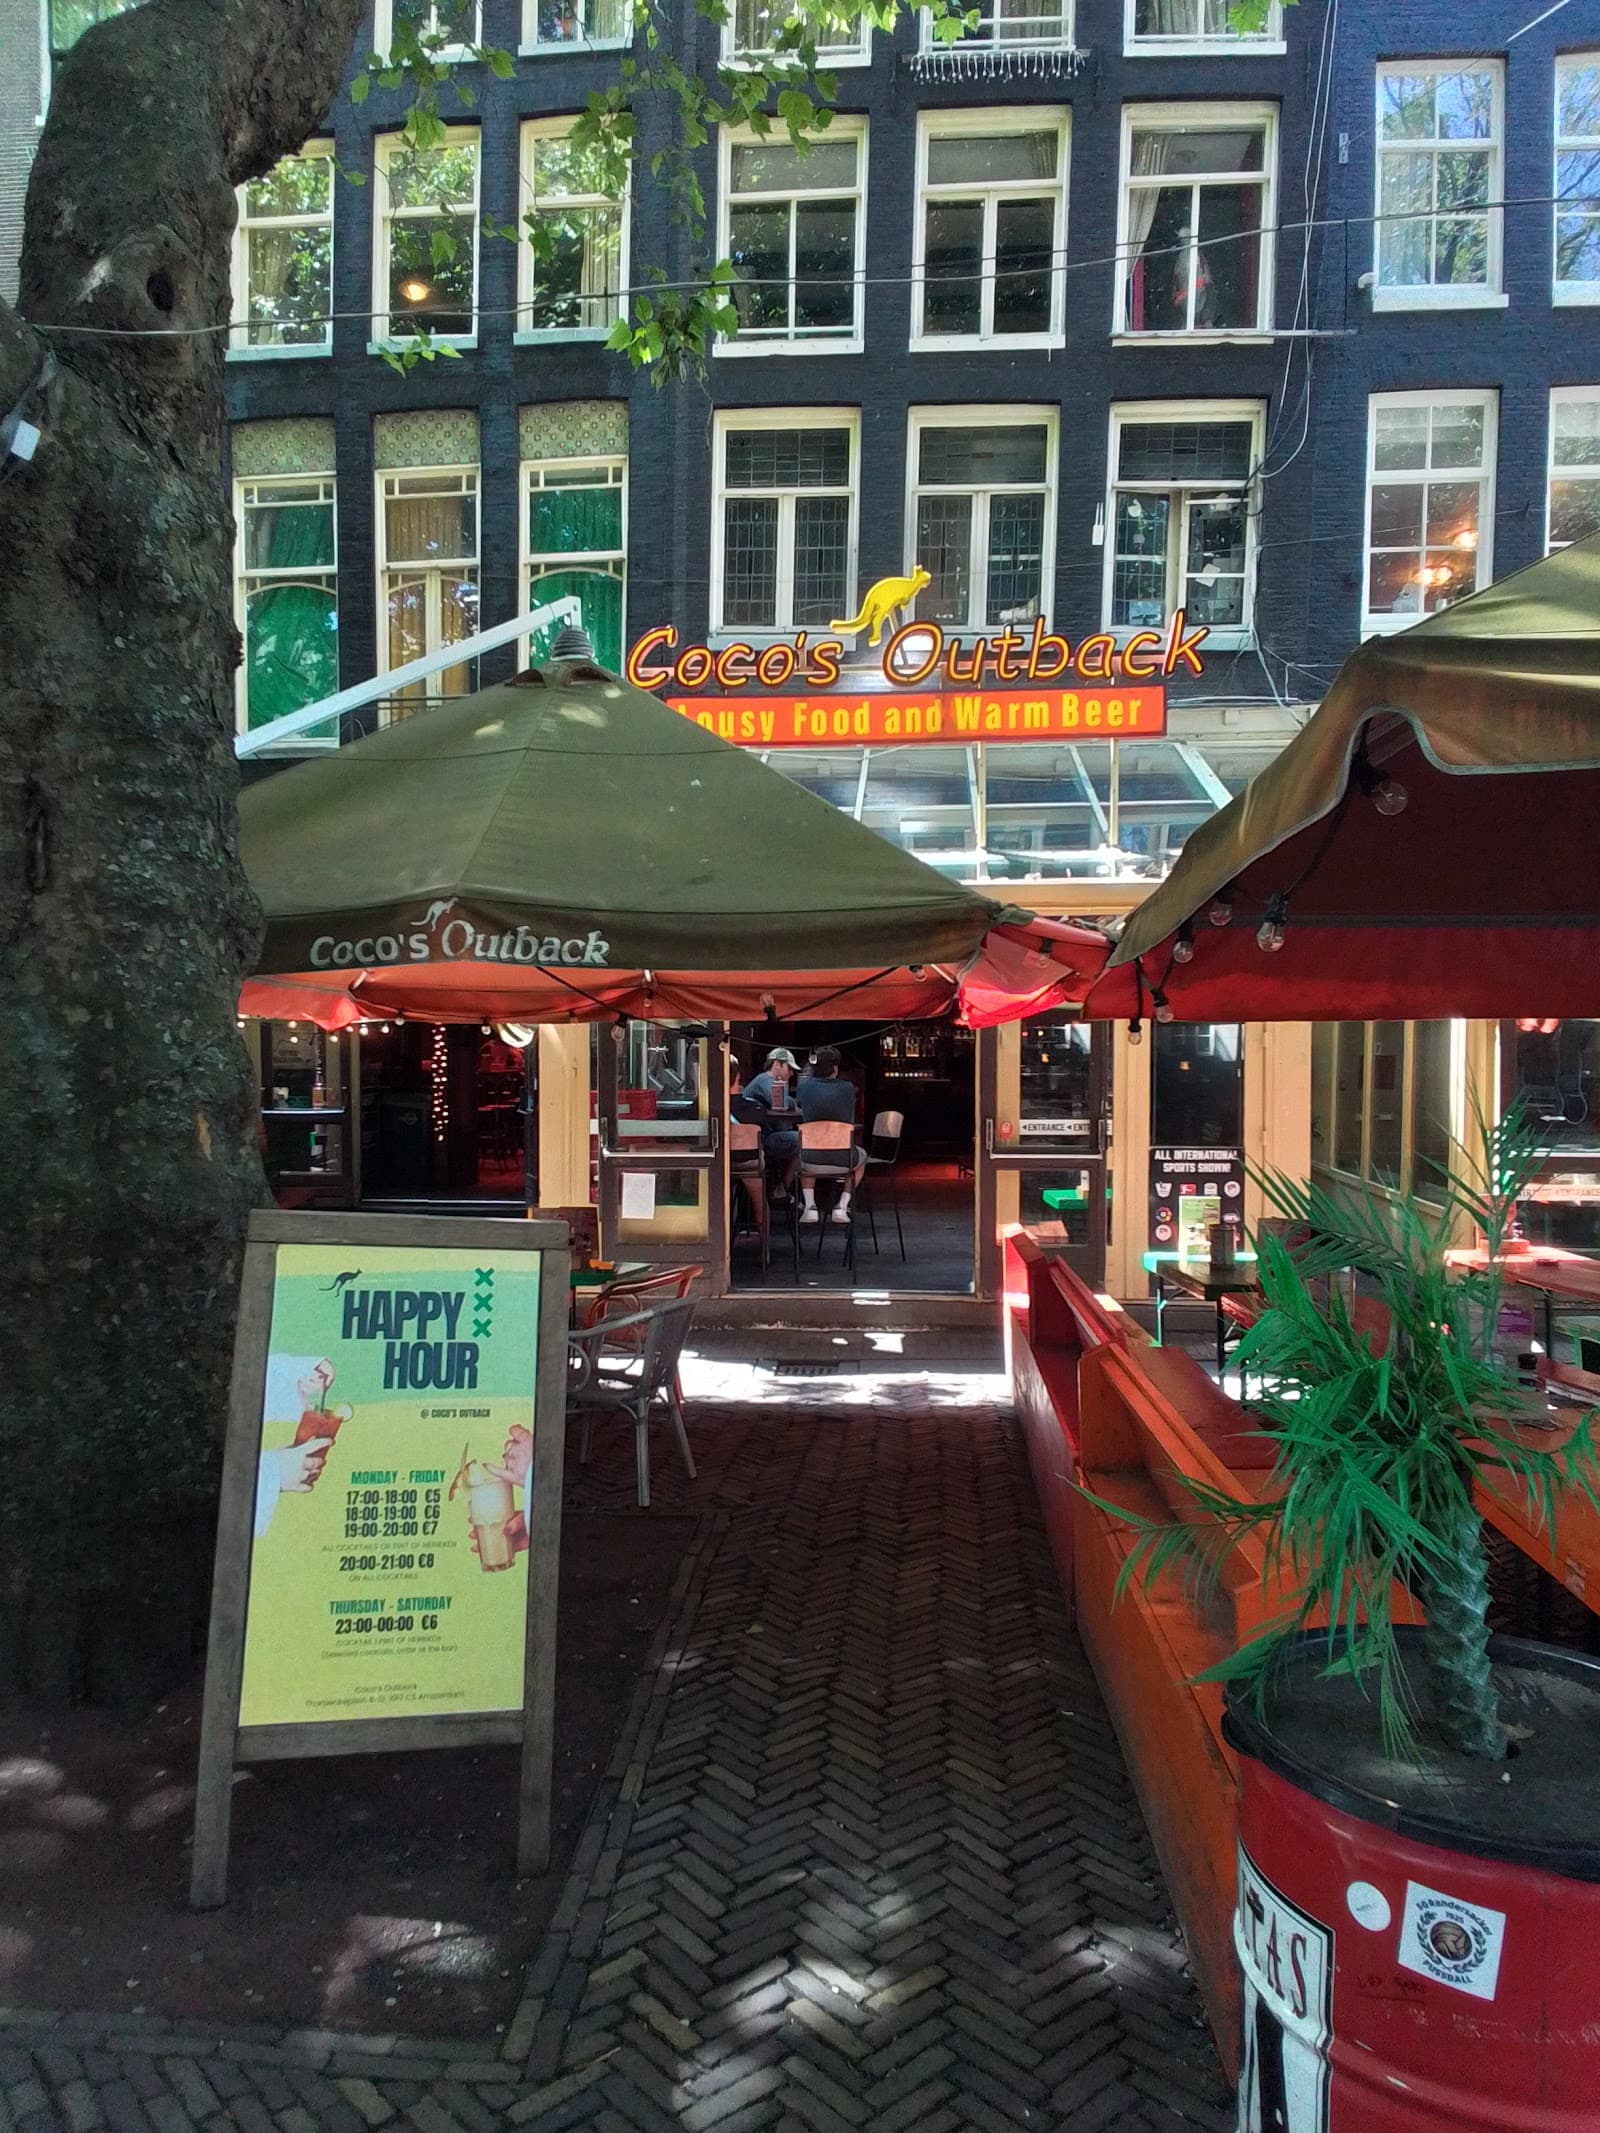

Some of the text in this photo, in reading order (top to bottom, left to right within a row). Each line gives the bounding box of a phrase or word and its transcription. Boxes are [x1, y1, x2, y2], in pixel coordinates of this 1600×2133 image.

[627, 608, 1211, 690] Coco's Outback
[677, 693, 1142, 742] ousy Food and Warm Beer
[310, 919, 610, 967] Coco's Outback
[1027, 1123, 1066, 1132] ENTRANCE
[1154, 1150, 1172, 1160] ALL
[1163, 1163, 1232, 1173] SPORTS SHOWN!
[342, 1289, 466, 1340] HAPPY
[383, 1341, 480, 1390] HOUR
[420, 1408, 430, 1419] @
[459, 1408, 491, 1418] OUTBACK
[351, 1470, 398, 1485] MONDAY
[409, 1470, 446, 1484] FRIDAY
[346, 1488, 441, 1505] 17:00-18:00 €5
[345, 1505, 441, 1521] 18:00-19:00 €6
[344, 1521, 438, 1538] 19:00-20:00 €7
[339, 1553, 435, 1571] 20:00-21:00 €8
[330, 1599, 385, 1614] THURSDAY
[397, 1596, 452, 1611] SATURDAY
[335, 1615, 438, 1634] 23:00-00:00 €6
[1423, 1959, 1473, 1985] FUSSBALL
